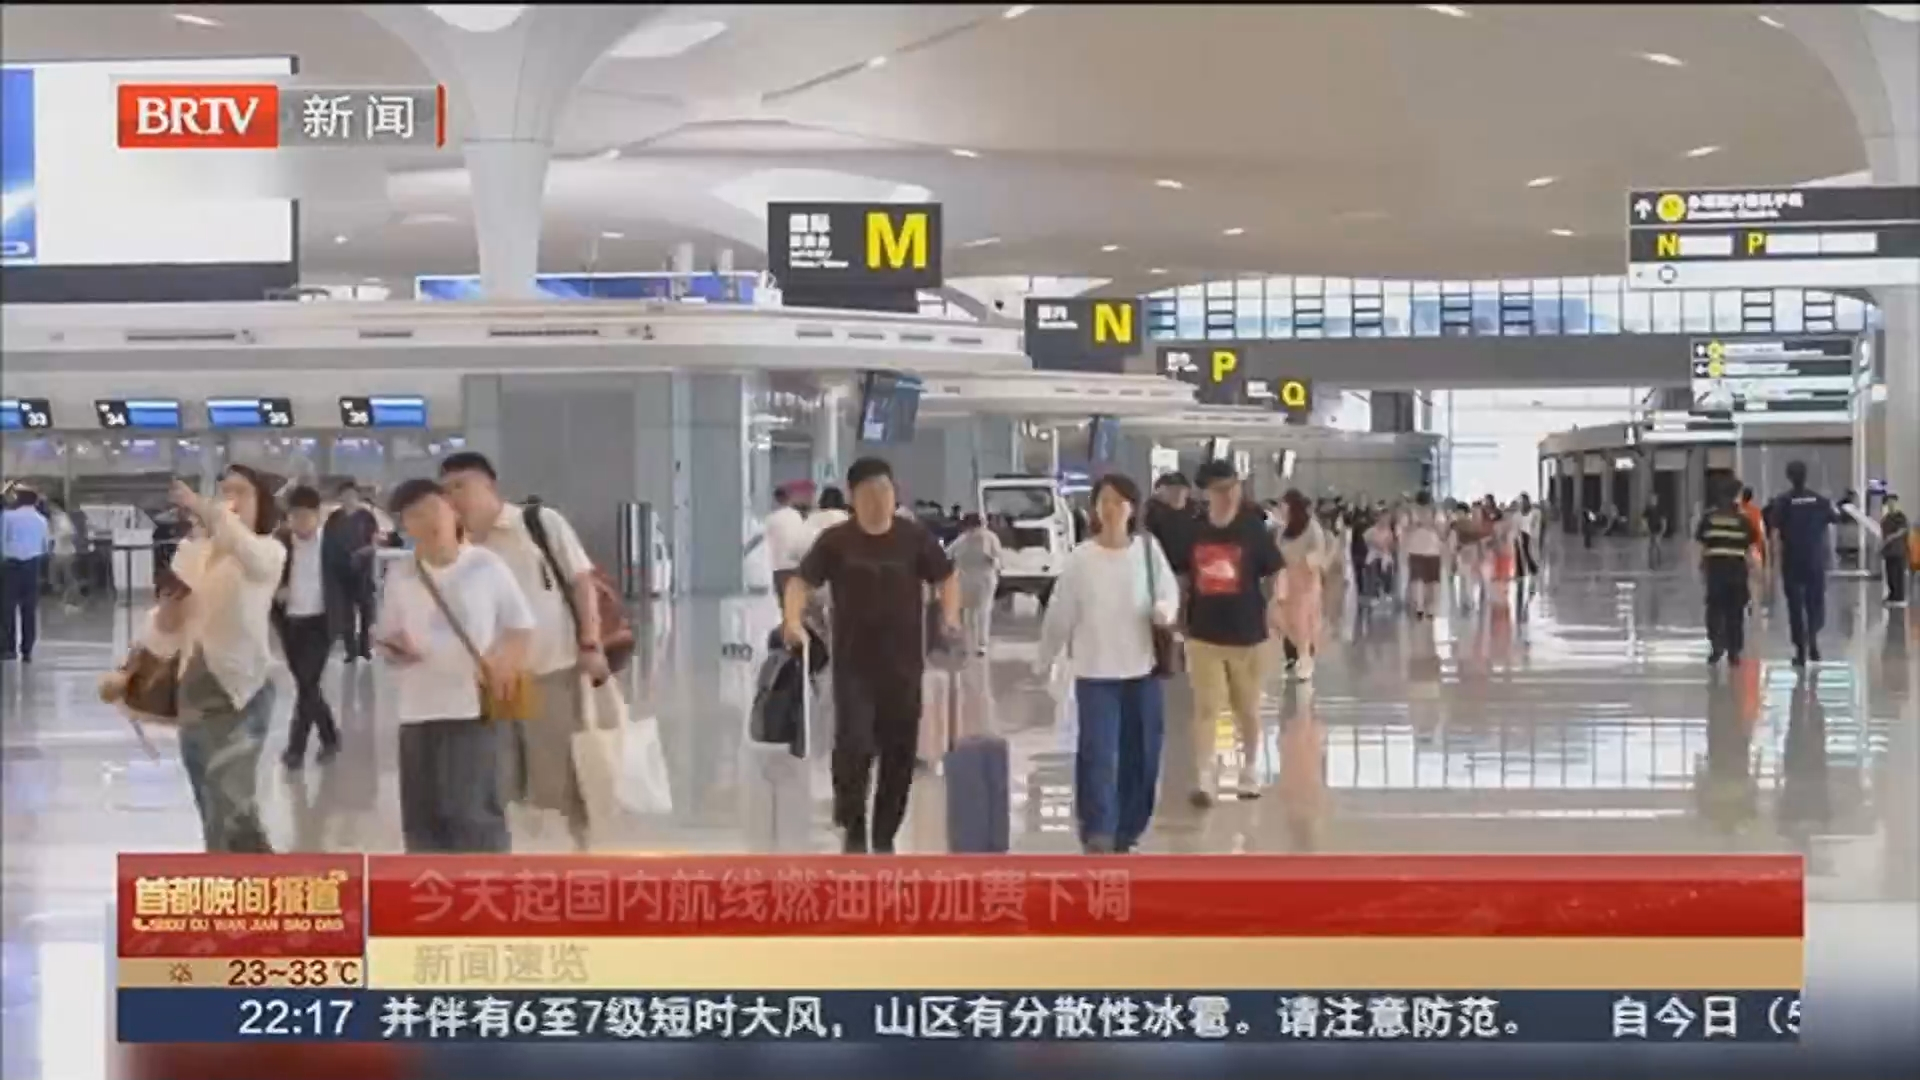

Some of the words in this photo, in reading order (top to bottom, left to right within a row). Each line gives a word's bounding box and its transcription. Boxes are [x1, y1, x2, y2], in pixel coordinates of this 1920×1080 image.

[866, 212, 929, 269] M
[1657, 233, 1680, 257] N
[1748, 233, 1766, 256] P
[1094, 303, 1133, 344] N
[1211, 351, 1237, 383] P
[1281, 380, 1306, 406] Q
[106, 411, 127, 426] 34
